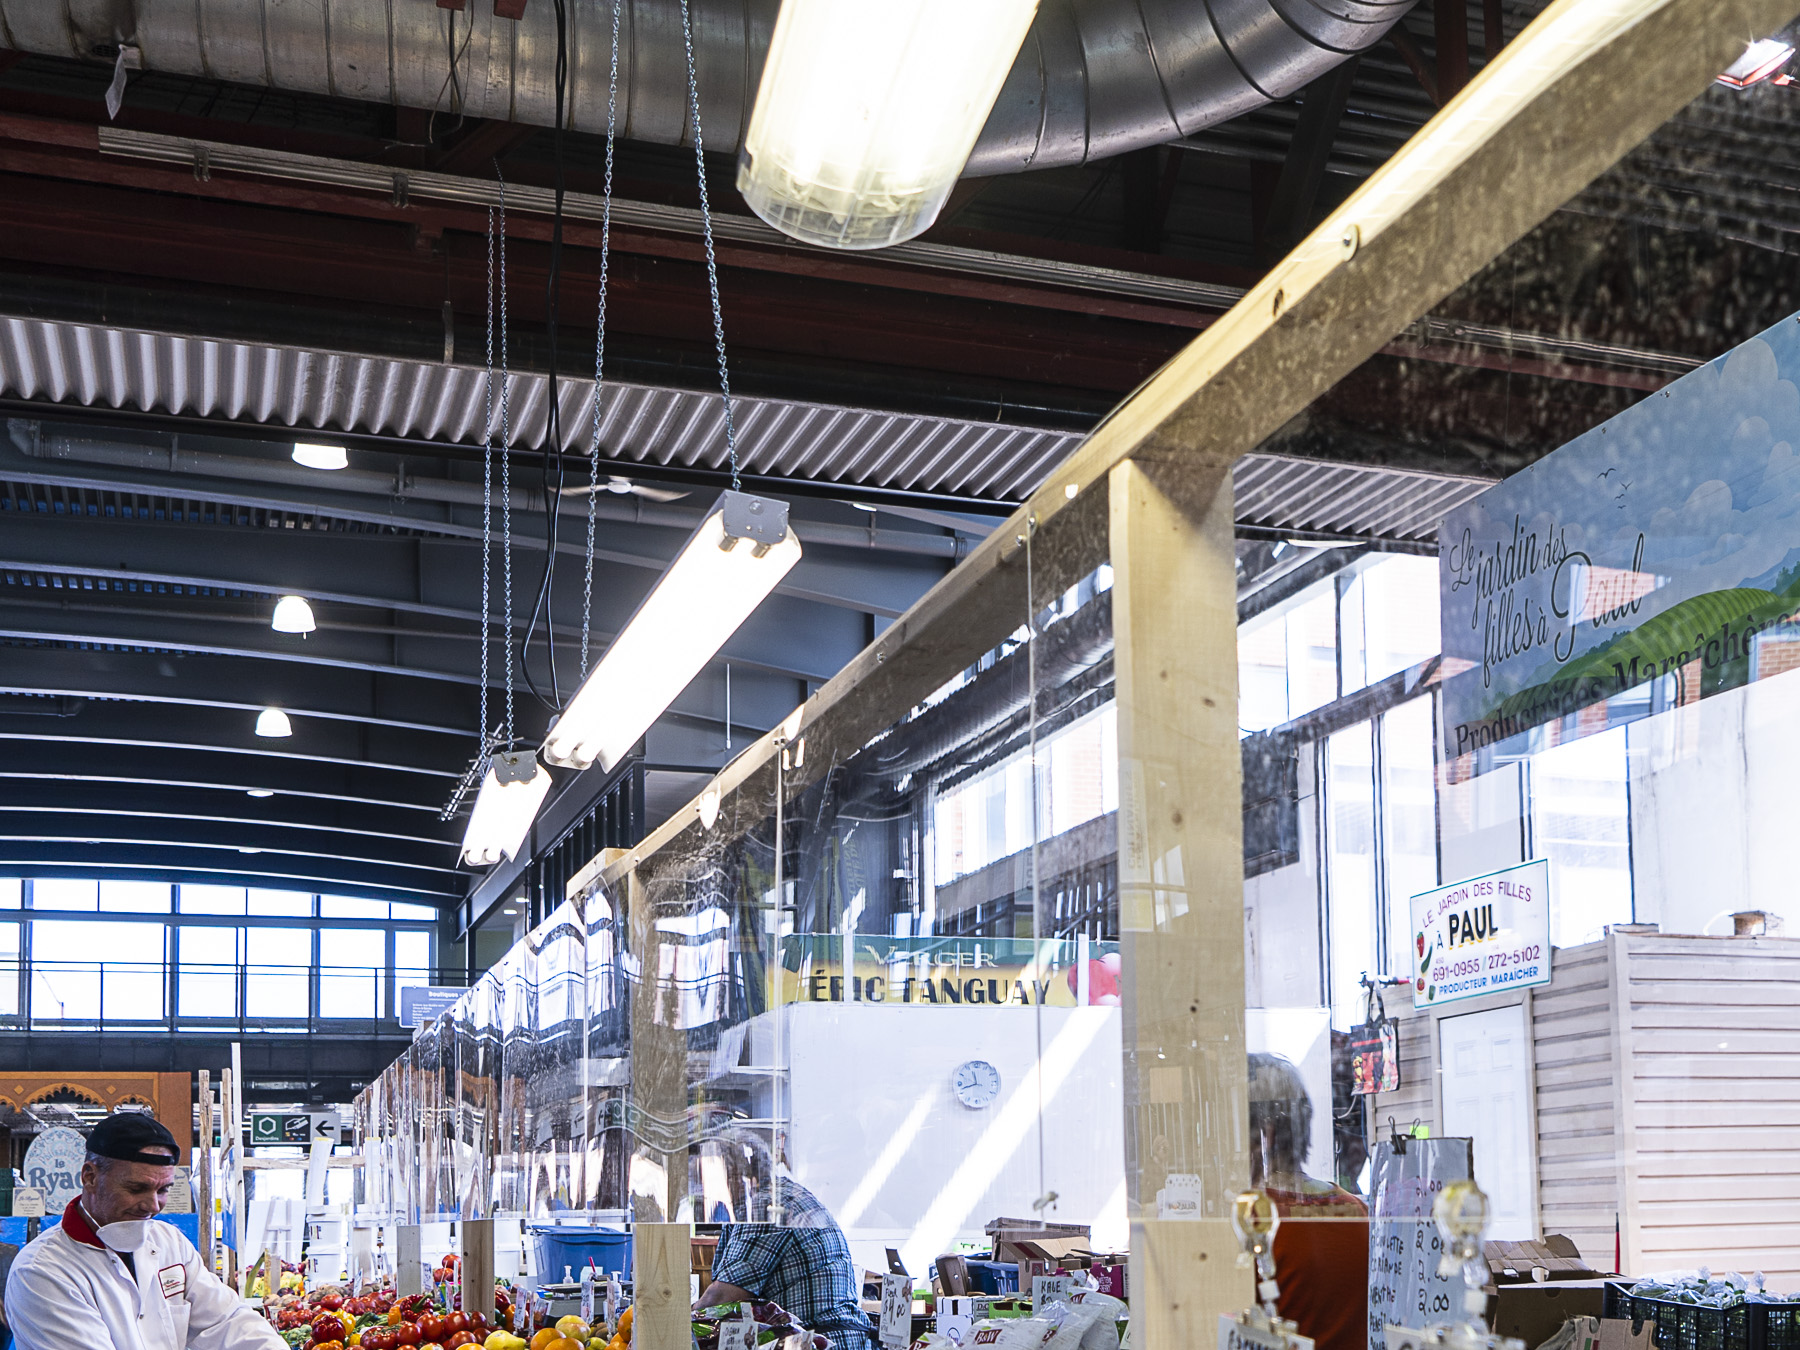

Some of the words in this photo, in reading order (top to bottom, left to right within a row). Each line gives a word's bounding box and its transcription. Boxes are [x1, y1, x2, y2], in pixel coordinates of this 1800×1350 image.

[1449, 527, 1476, 592] Le
[1471, 514, 1541, 629] jardin
[1543, 522, 1569, 571] des
[1483, 588, 1535, 689] filles
[1536, 606, 1549, 647] à
[1550, 531, 1645, 664] Paul
[1422, 909, 1435, 929] LE
[1437, 887, 1469, 916] JARDIN
[1473, 881, 1494, 898] DES
[1498, 881, 1532, 903] FILLES
[1449, 903, 1500, 949] PAUL
[1433, 957, 1481, 982] 691-0955
[1487, 944, 1540, 971] 272-5102
[903, 977, 1052, 1005] TANGUAY
[1438, 976, 1488, 996] PRODUCTEUR
[1418, 1289, 1450, 1316] 2.00
[975, 1329, 1001, 1344] B&W
